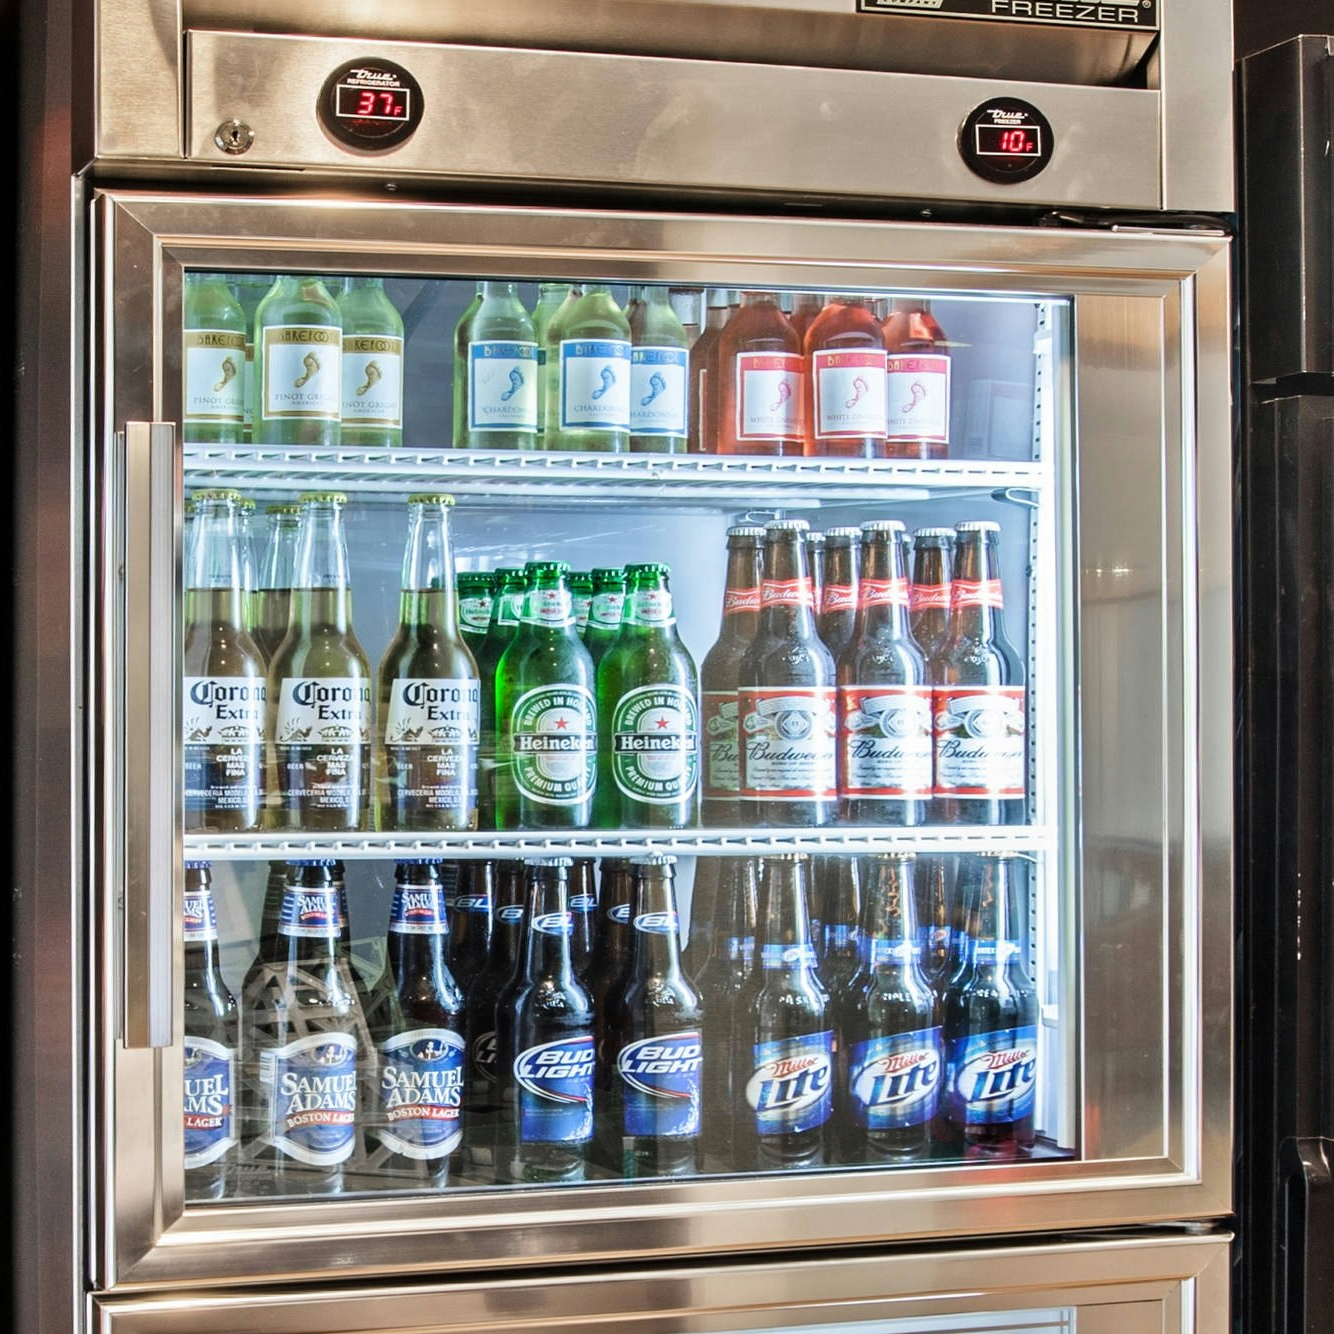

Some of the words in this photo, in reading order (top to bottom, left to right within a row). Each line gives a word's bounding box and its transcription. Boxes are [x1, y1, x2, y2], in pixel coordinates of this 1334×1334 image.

[992, 0, 1139, 23] FREEZER
[358, 92, 394, 114] 37
[1002, 131, 1025, 151] 10
[190, 680, 267, 708] Corona
[292, 680, 371, 709] Corona
[403, 681, 479, 709] Corona
[216, 704, 259, 720] Extra
[318, 704, 362, 720] Extra
[624, 697, 652, 726] BREWED
[653, 696, 665, 706] IN
[519, 736, 596, 751] Heineken
[620, 735, 696, 750] Heineken
[625, 766, 663, 792] PREMIUM
[535, 1050, 595, 1066] BUD
[636, 1045, 701, 1061] BUD
[879, 1051, 931, 1073] Miller
[519, 1061, 596, 1079] LIGHT
[619, 1057, 704, 1075] LIGHT
[770, 1056, 820, 1080] Miller
[380, 1065, 464, 1090] SAMUEL
[756, 1062, 831, 1113] Lite
[867, 1056, 938, 1108] Lite
[965, 1053, 1037, 1104] Lite
[286, 1092, 357, 1116] ADAMS
[386, 1086, 461, 1108] ADAMS
[187, 1116, 223, 1129] LAGER
[388, 1107, 430, 1122] BOSTON
[432, 1107, 460, 1119] LAGER
